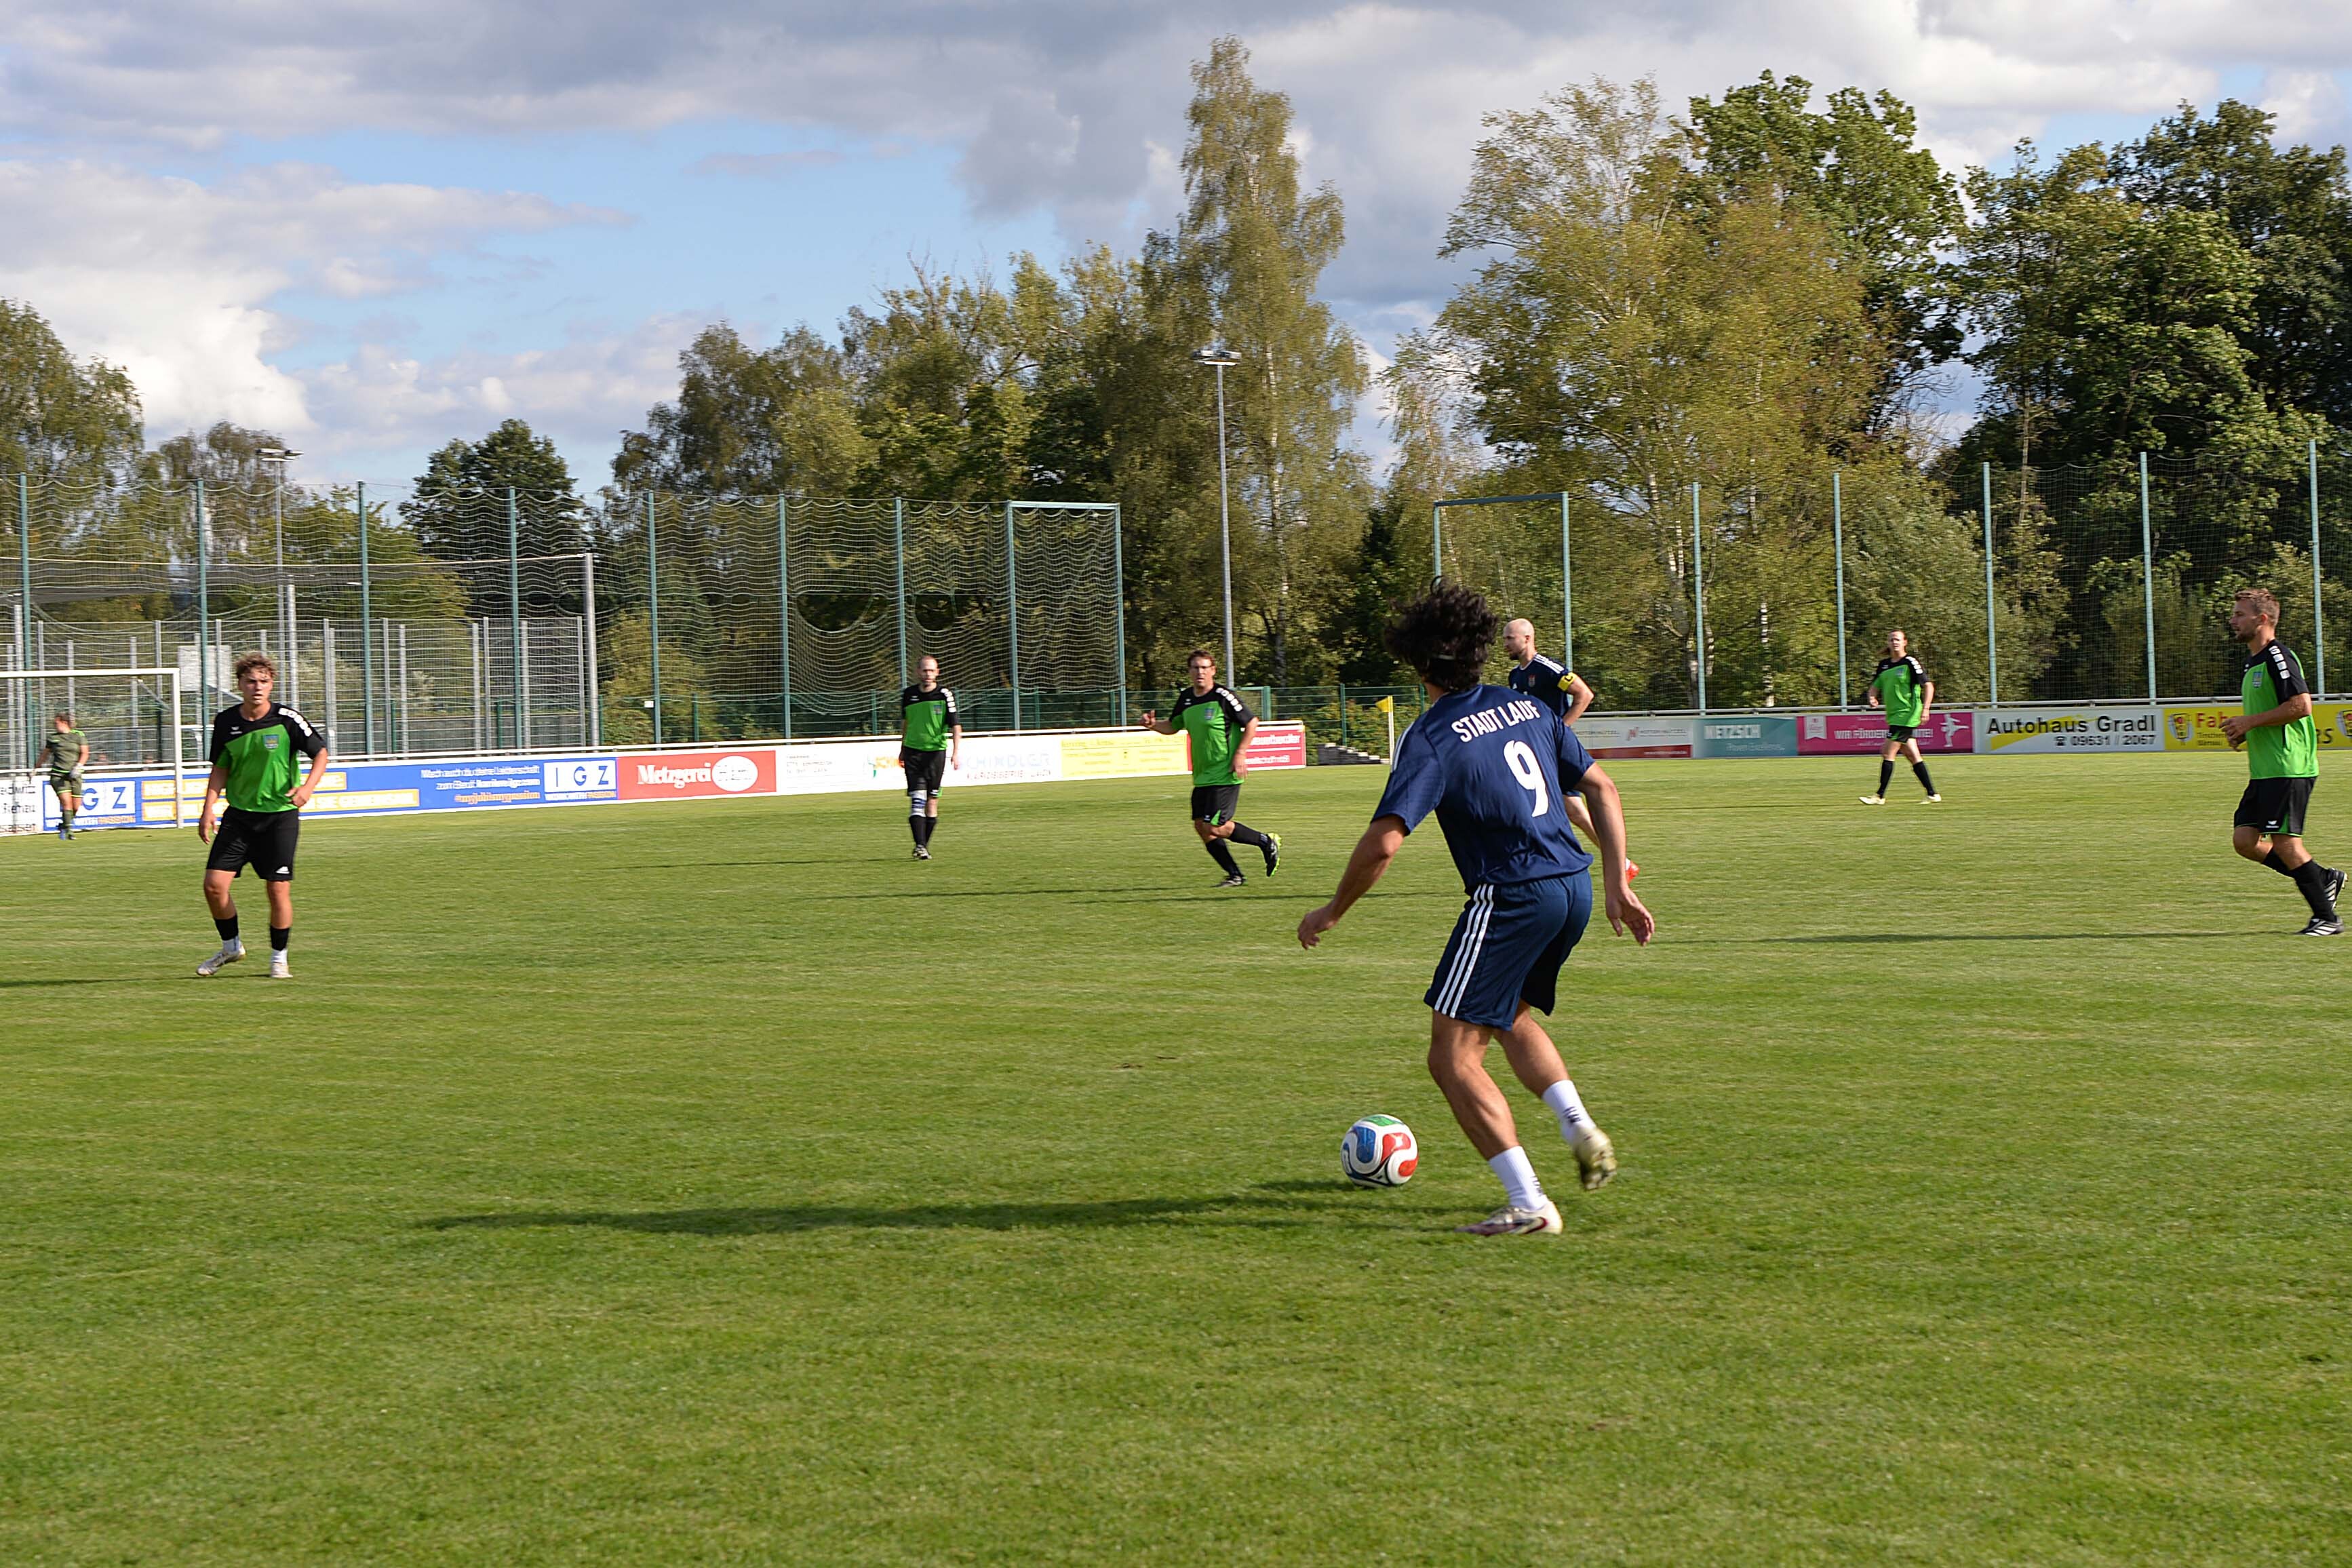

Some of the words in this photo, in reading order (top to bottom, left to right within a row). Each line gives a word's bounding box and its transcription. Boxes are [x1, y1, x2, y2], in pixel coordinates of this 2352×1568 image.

[1451, 709, 1504, 743] STADT
[1497, 700, 1541, 727] LAUF
[1704, 724, 1762, 739] NETZSCH
[1987, 717, 2089, 734] Autohaus
[2096, 714, 2157, 733] Gradl
[2070, 735, 2111, 746] 09631
[2122, 734, 2157, 745] 2067
[636, 762, 712, 789] Metzgerei
[1503, 740, 1549, 818] 9
